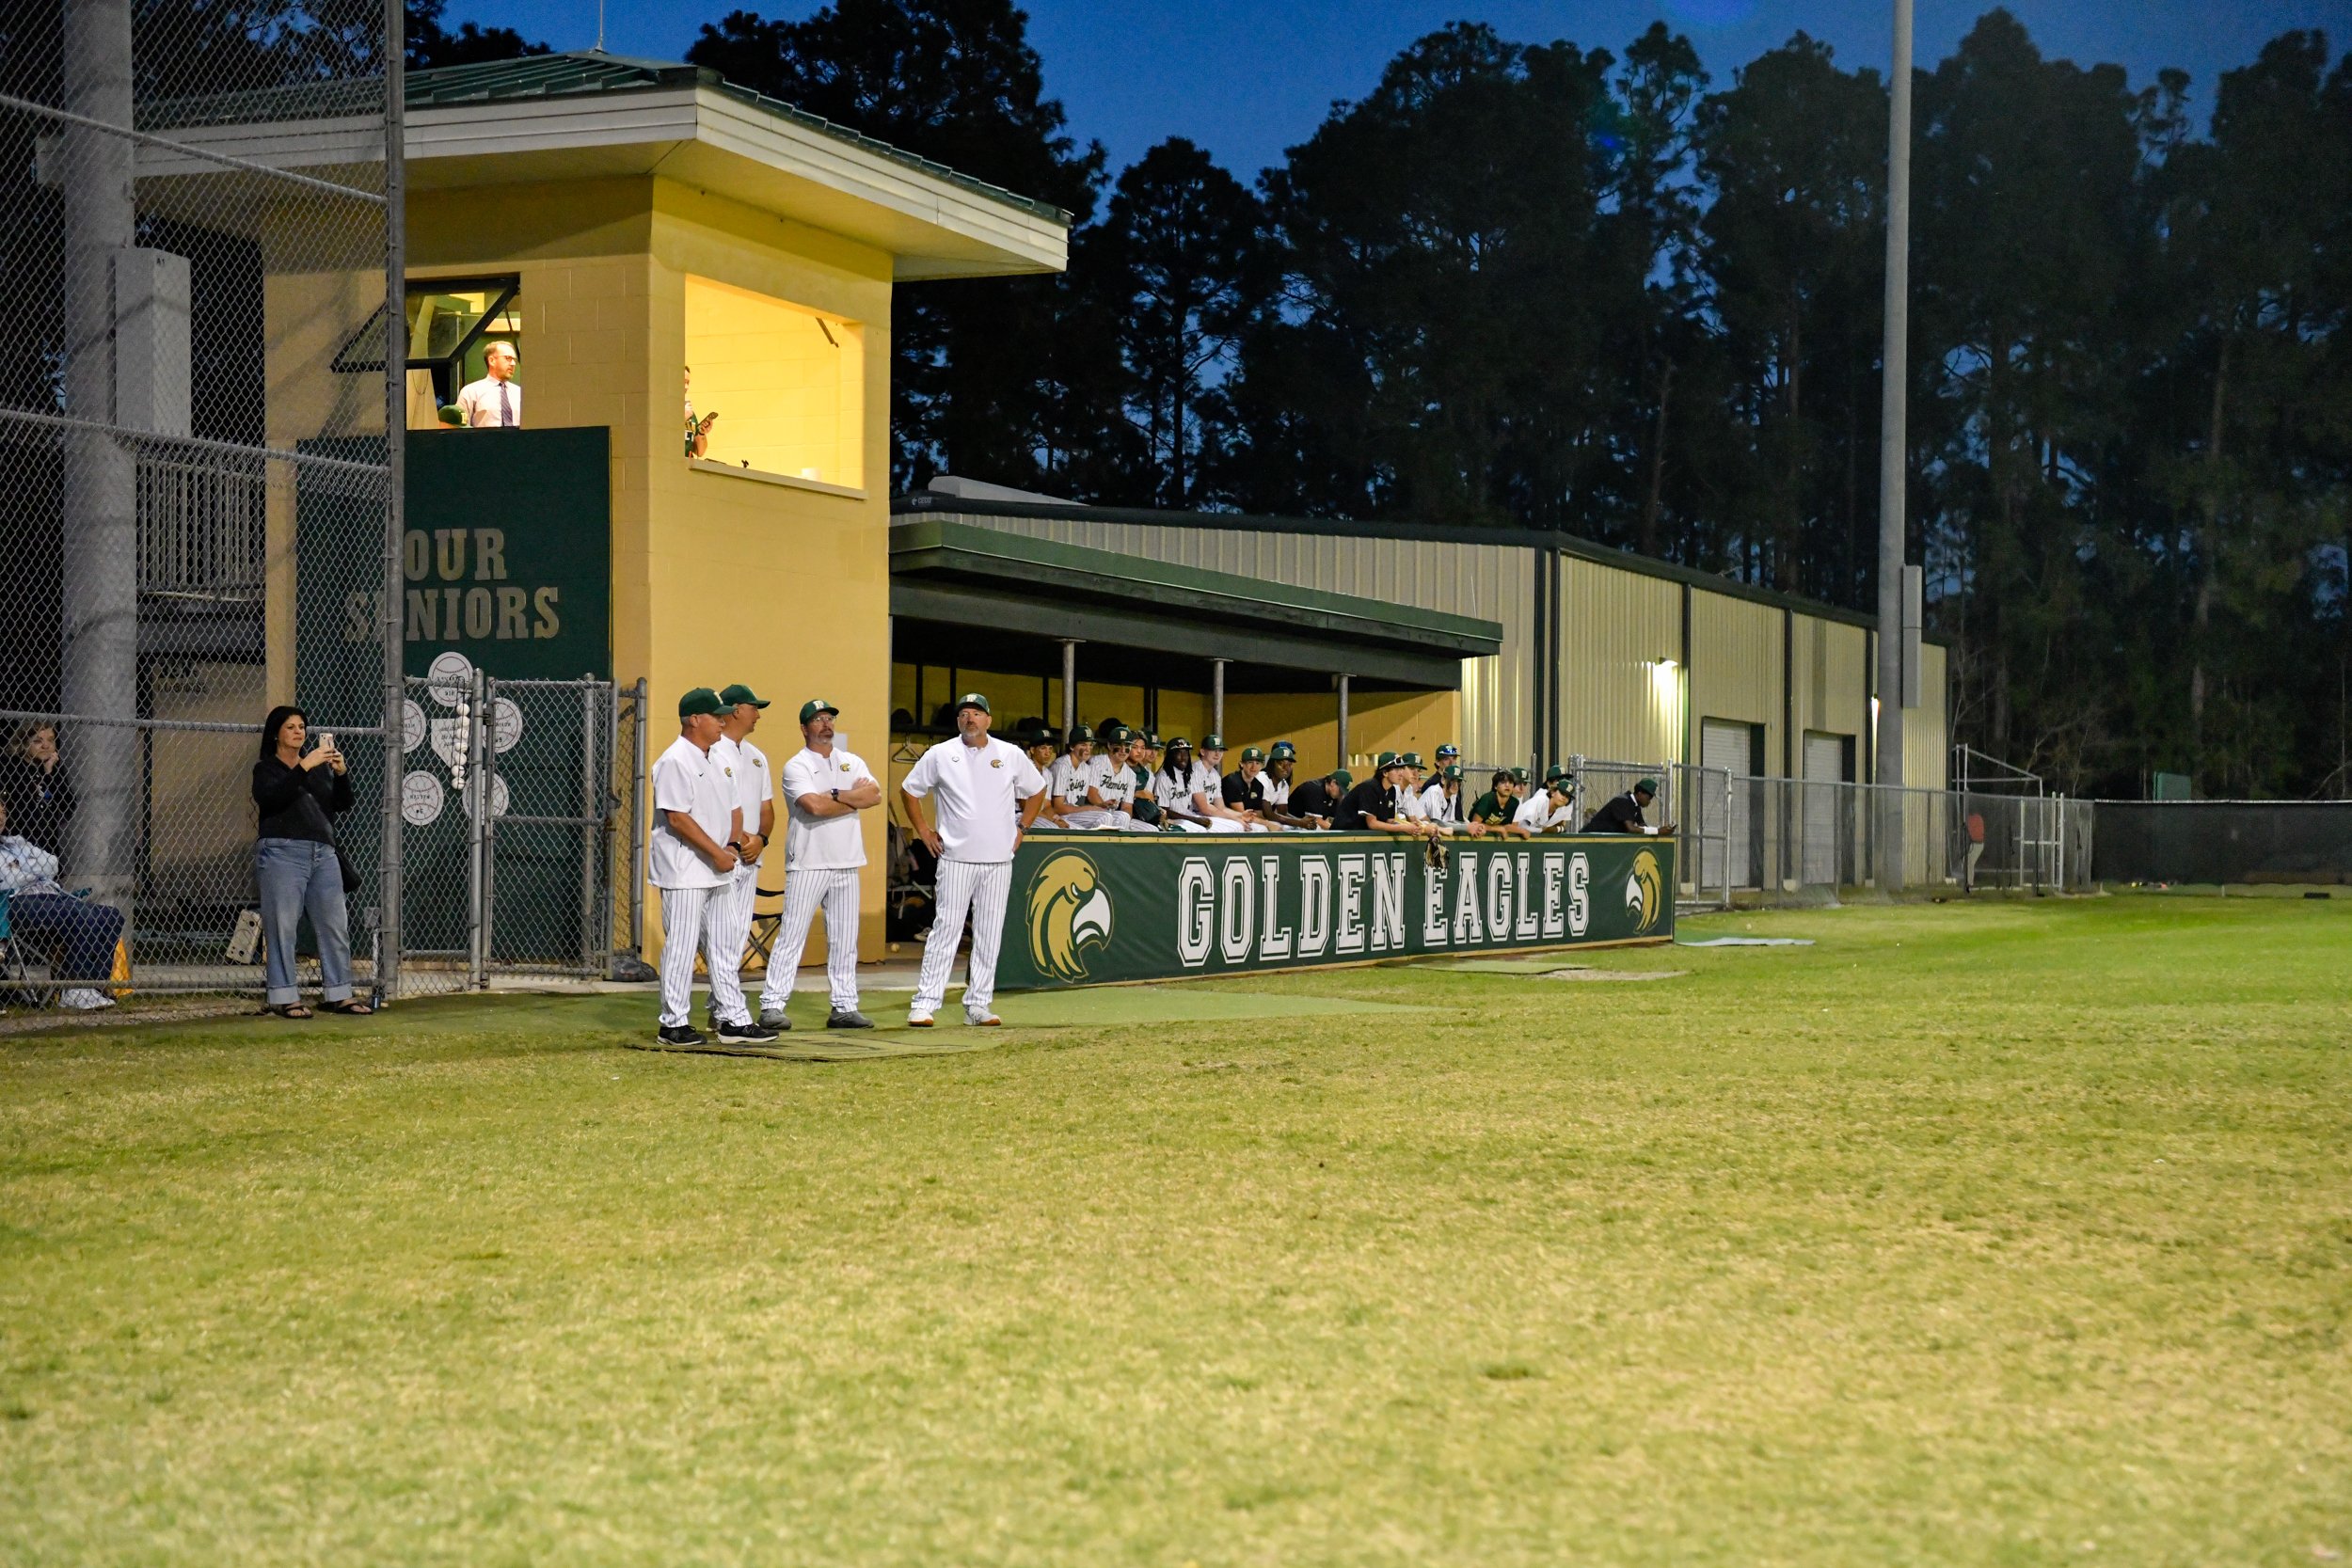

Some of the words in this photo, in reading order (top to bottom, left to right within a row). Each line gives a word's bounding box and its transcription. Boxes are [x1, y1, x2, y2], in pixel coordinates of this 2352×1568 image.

[404, 529, 507, 580] OUR
[1100, 774, 1129, 795] Fleming
[1177, 852, 1406, 968] GOLDEN
[1422, 851, 1590, 947] EAGLES
